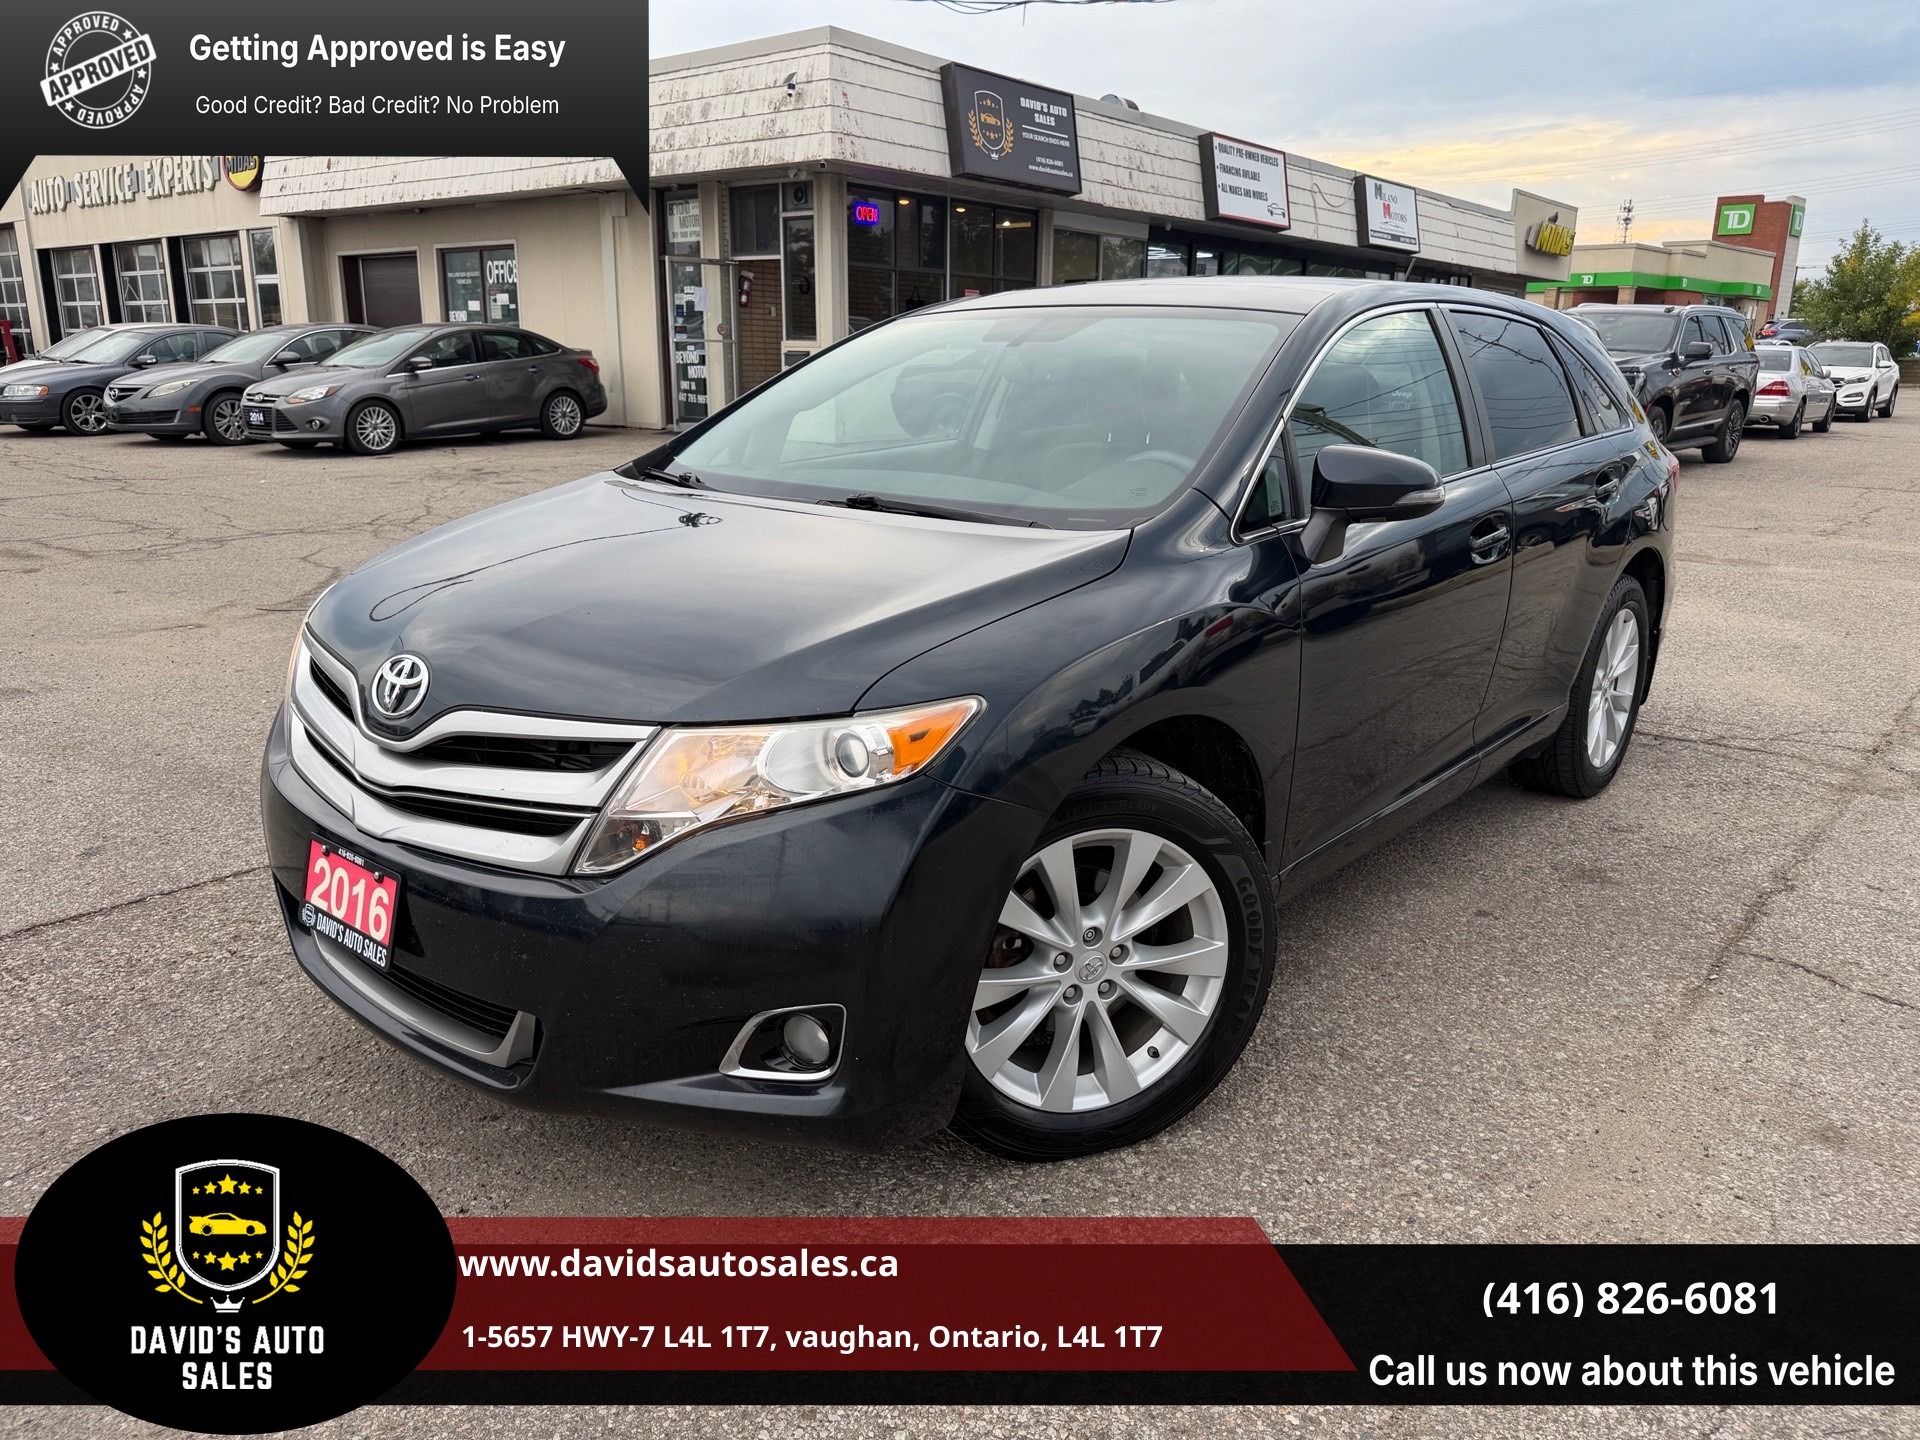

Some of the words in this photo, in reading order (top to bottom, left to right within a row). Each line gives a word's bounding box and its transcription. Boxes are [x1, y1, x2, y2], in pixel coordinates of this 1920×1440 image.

[1020, 97, 1048, 112] DAVID'S
[1049, 105, 1067, 117] AUTO
[1034, 113, 1055, 126] SALES
[1022, 132, 1034, 140] YOUR
[1218, 143, 1235, 156] QUALITY
[1235, 147, 1260, 162] PRE-OWNED
[1260, 154, 1278, 167] VEHICLES
[225, 156, 256, 175] MIDAS
[1219, 163, 1241, 177] FINANCING
[30, 174, 67, 215] AUTO
[72, 162, 136, 209] SERVICE
[143, 155, 215, 200] EXPERTS
[1228, 185, 1242, 196] MAKES
[1243, 188, 1251, 198] AND
[1252, 190, 1268, 201] MODELS
[856, 206, 878, 222] OPEN
[1724, 210, 1751, 229] TD
[1794, 211, 1804, 230] TD
[1535, 222, 1576, 256] MIDAS
[487, 260, 518, 284] OFFICE
[1581, 275, 1593, 284] TD
[675, 350, 700, 364] BEYOND
[687, 365, 707, 379] MOTO
[1392, 390, 1413, 399] Jeep
[249, 412, 264, 422] 2014
[310, 857, 390, 942] 2016
[316, 912, 344, 943] DAVID'S
[343, 928, 364, 954] AUTO
[363, 938, 387, 967] SALES
